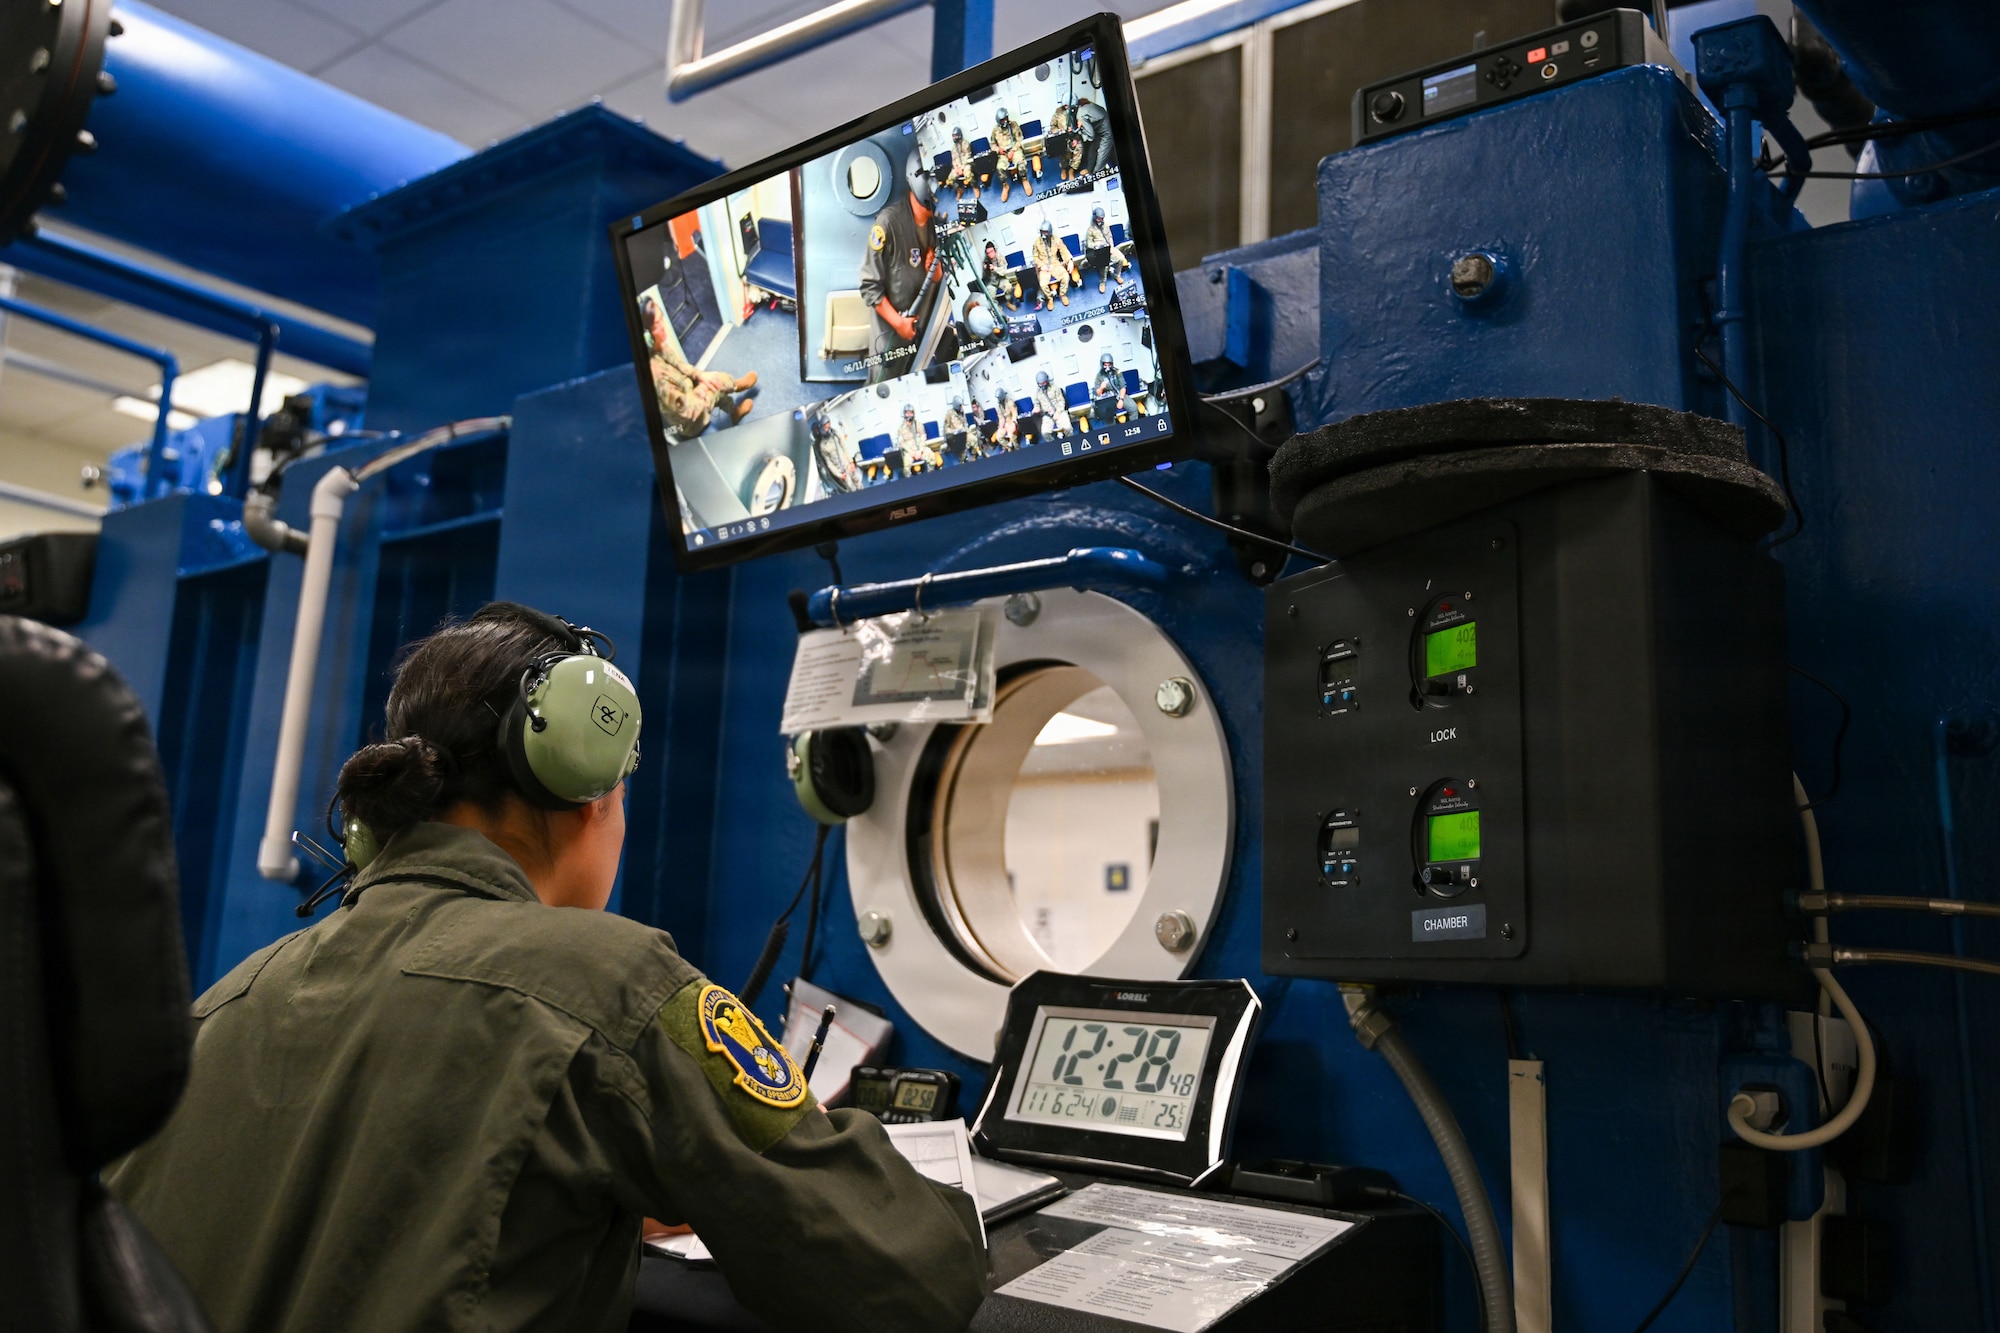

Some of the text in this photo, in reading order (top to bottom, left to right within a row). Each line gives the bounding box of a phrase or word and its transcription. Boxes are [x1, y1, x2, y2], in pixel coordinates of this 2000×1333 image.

[1036, 165, 1119, 201] 06/11/2026 12:58:44
[1061, 294, 1146, 326] 06/11/2026 12:58:45
[843, 344, 917, 374] 06/11/2026 12:58:44
[1124, 427, 1141, 437] 12:58
[890, 506, 918, 521] ASUS
[1430, 727, 1457, 743] LOCK
[1424, 916, 1468, 931] CHAMBER
[1117, 992, 1148, 1002] LORELL
[1052, 1024, 1195, 1096] 12:28 48
